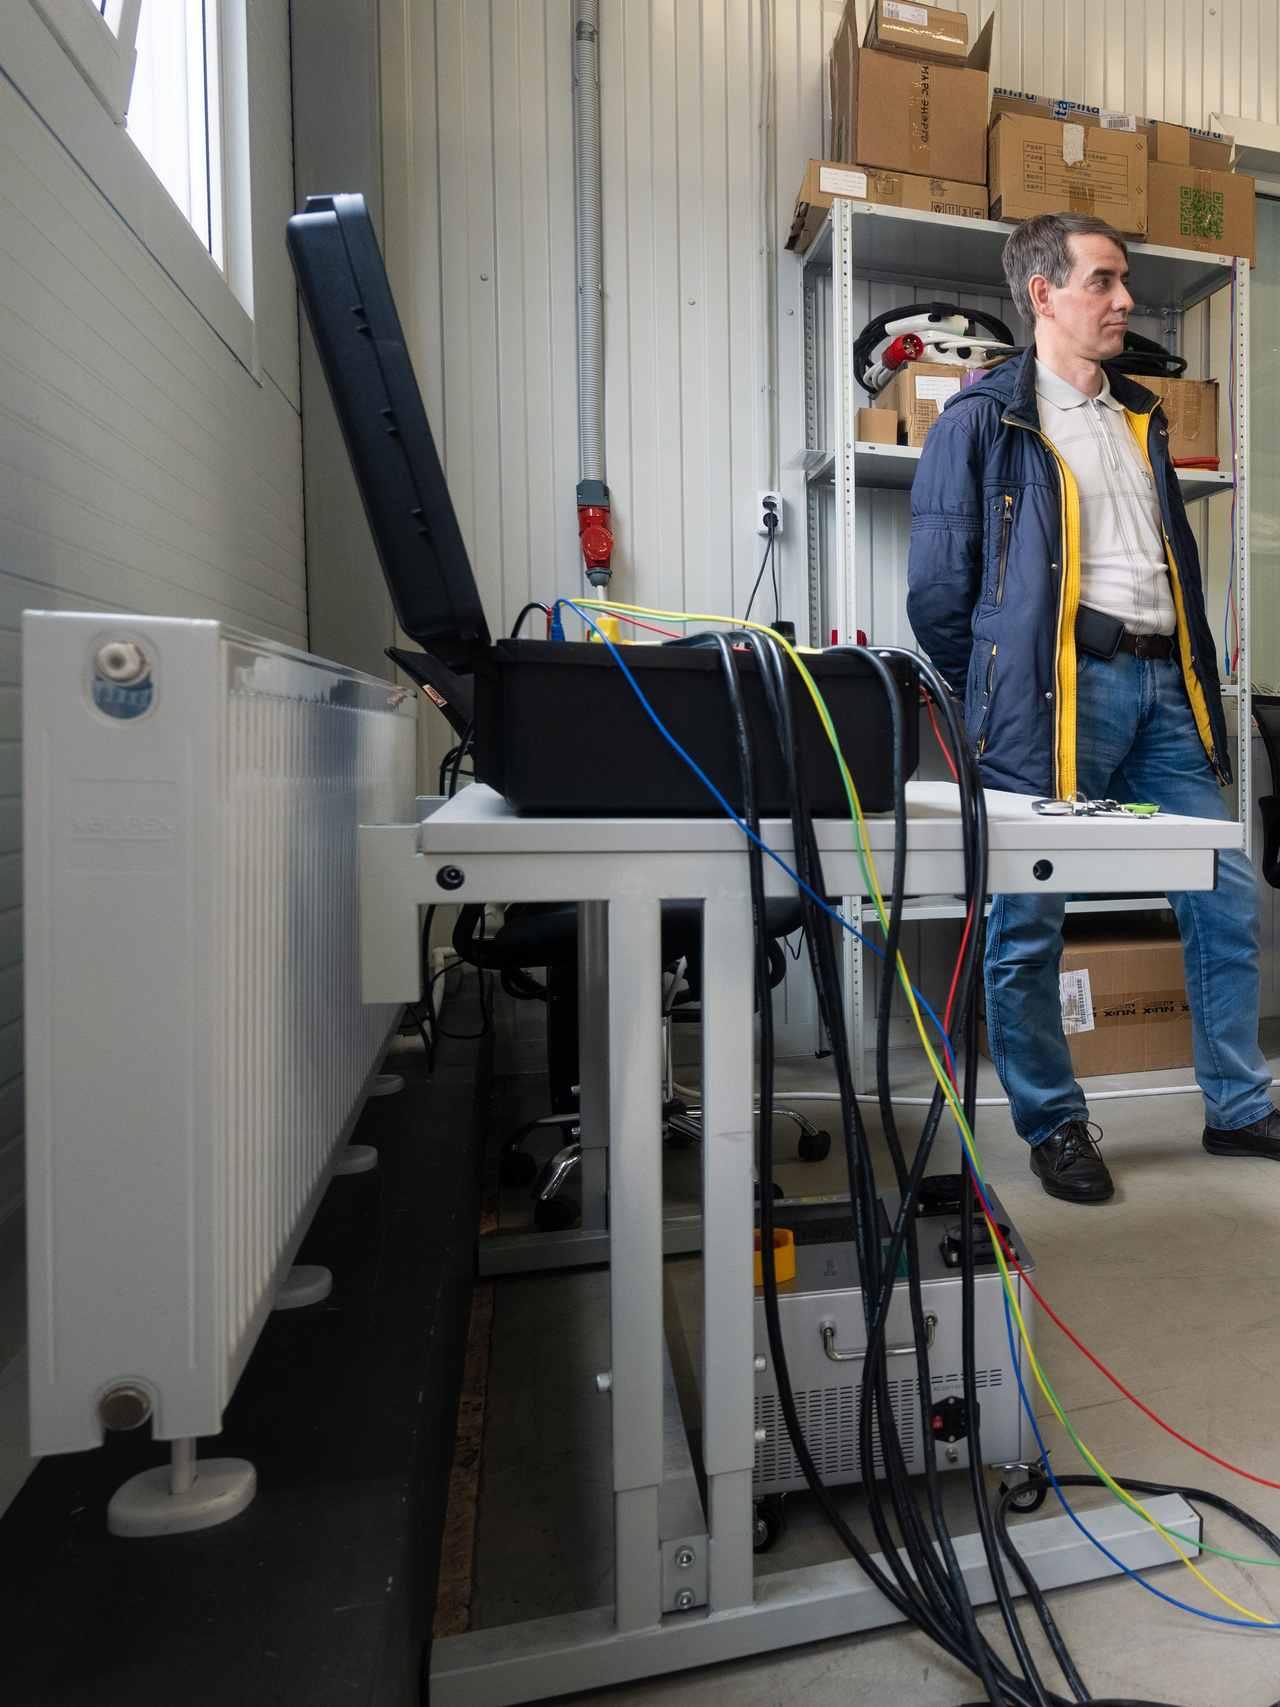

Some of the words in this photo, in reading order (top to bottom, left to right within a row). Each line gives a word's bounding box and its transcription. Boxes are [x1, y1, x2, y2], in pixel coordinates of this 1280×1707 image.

[921, 66, 929, 96] МАРС
[1104, 1008, 1136, 1017] NUX
[1142, 1006, 1174, 1015] NUX
